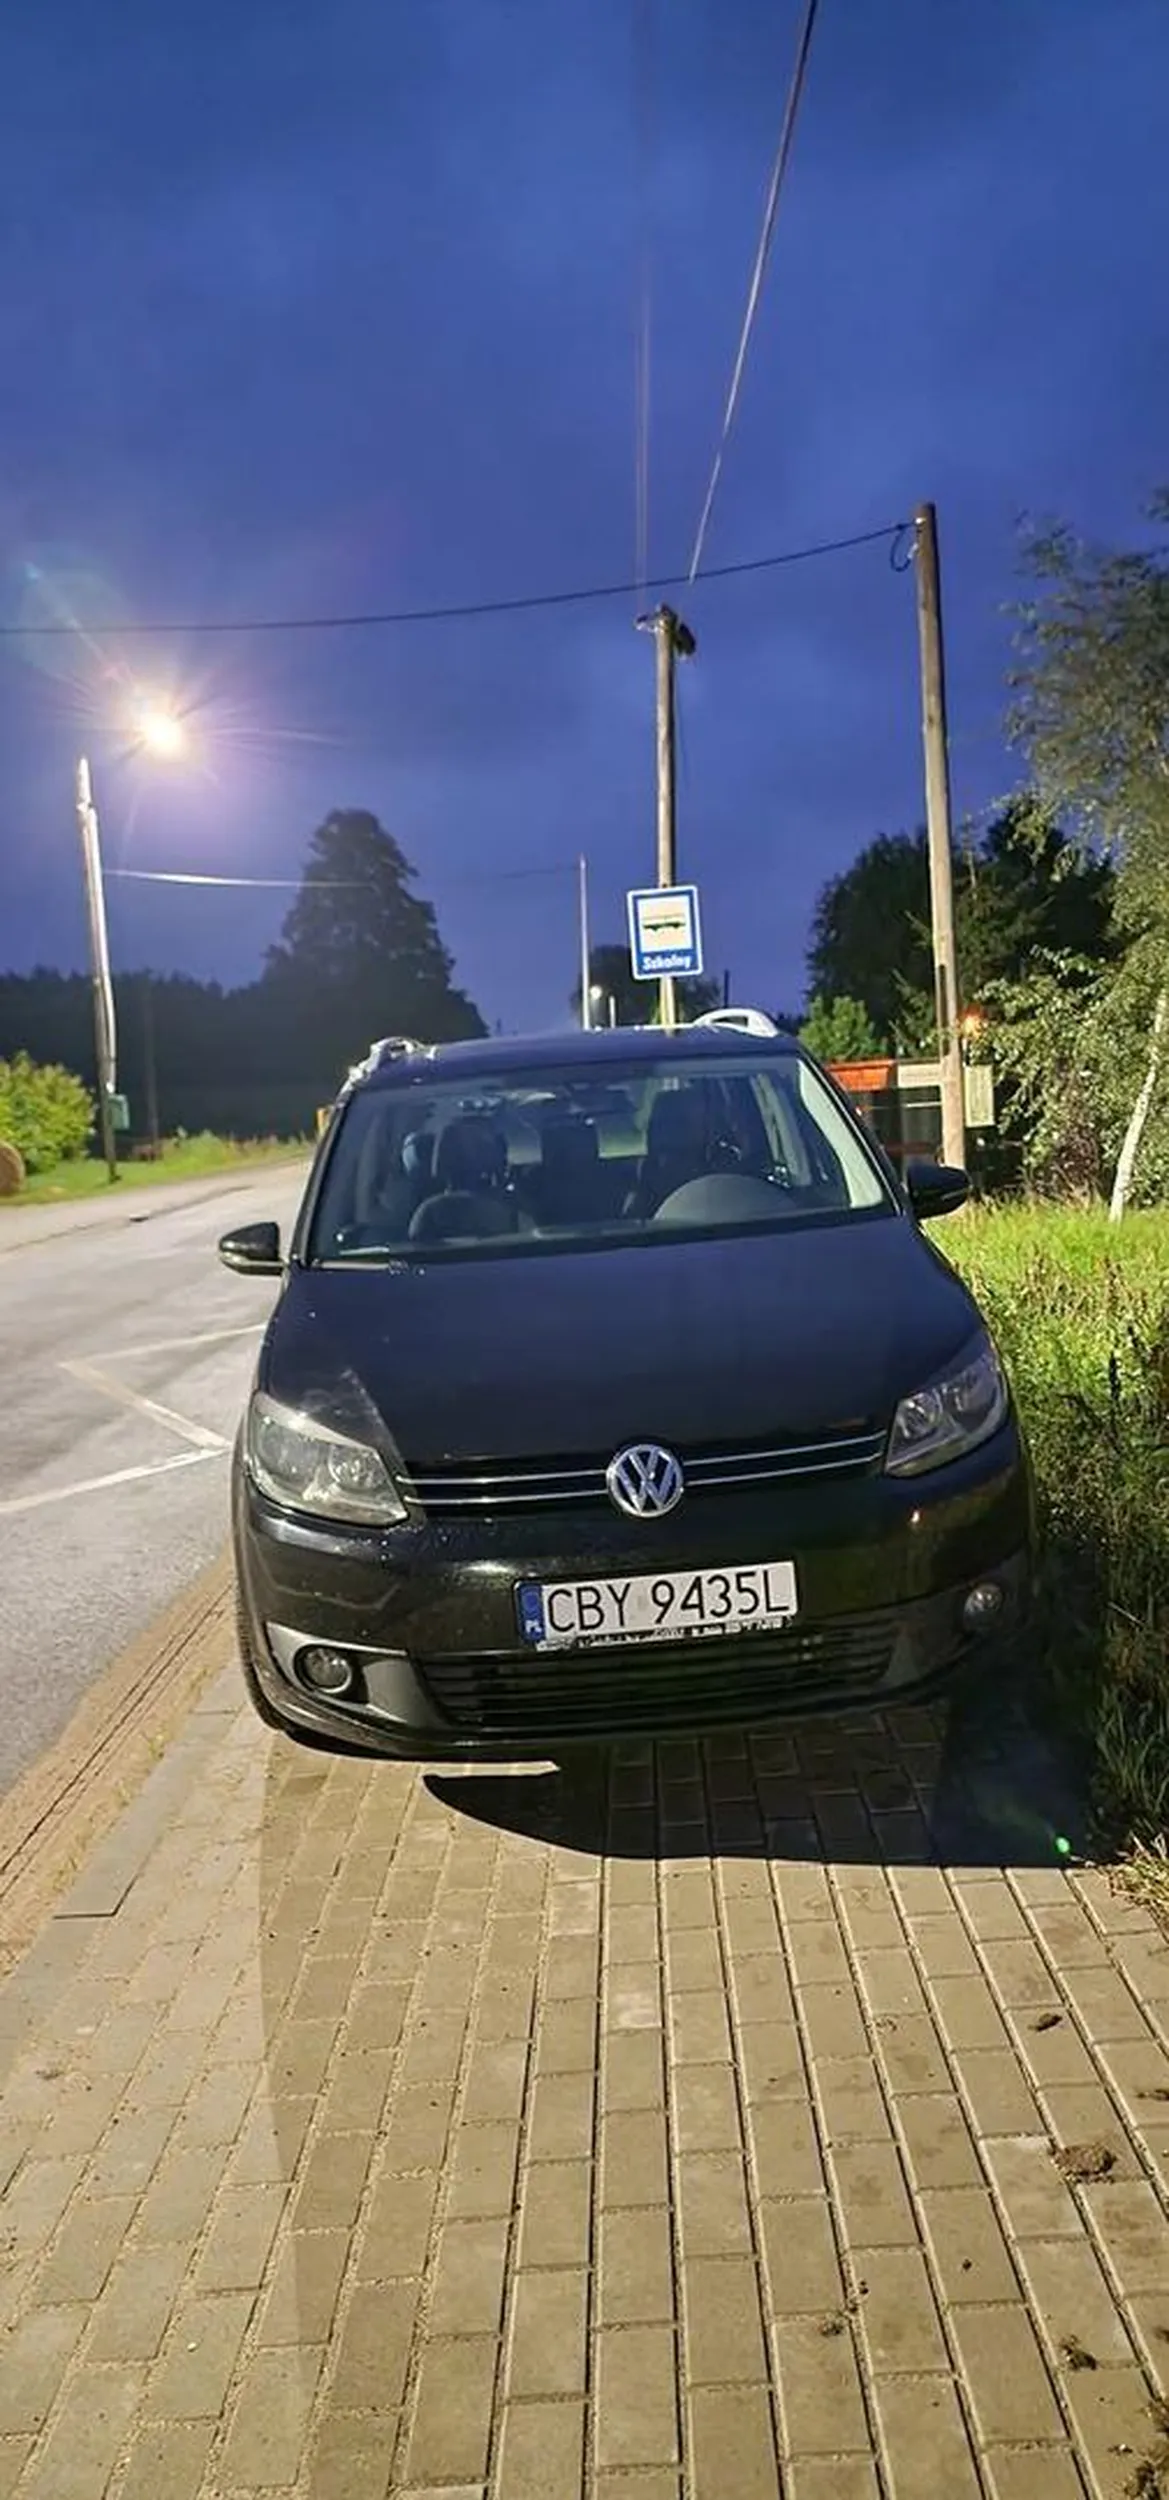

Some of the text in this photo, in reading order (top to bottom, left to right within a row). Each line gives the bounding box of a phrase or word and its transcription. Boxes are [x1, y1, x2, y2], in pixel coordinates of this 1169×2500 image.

[546, 1583, 631, 1633] CBY
[651, 1570, 790, 1624] 9435L
[525, 1619, 542, 1633] PL
